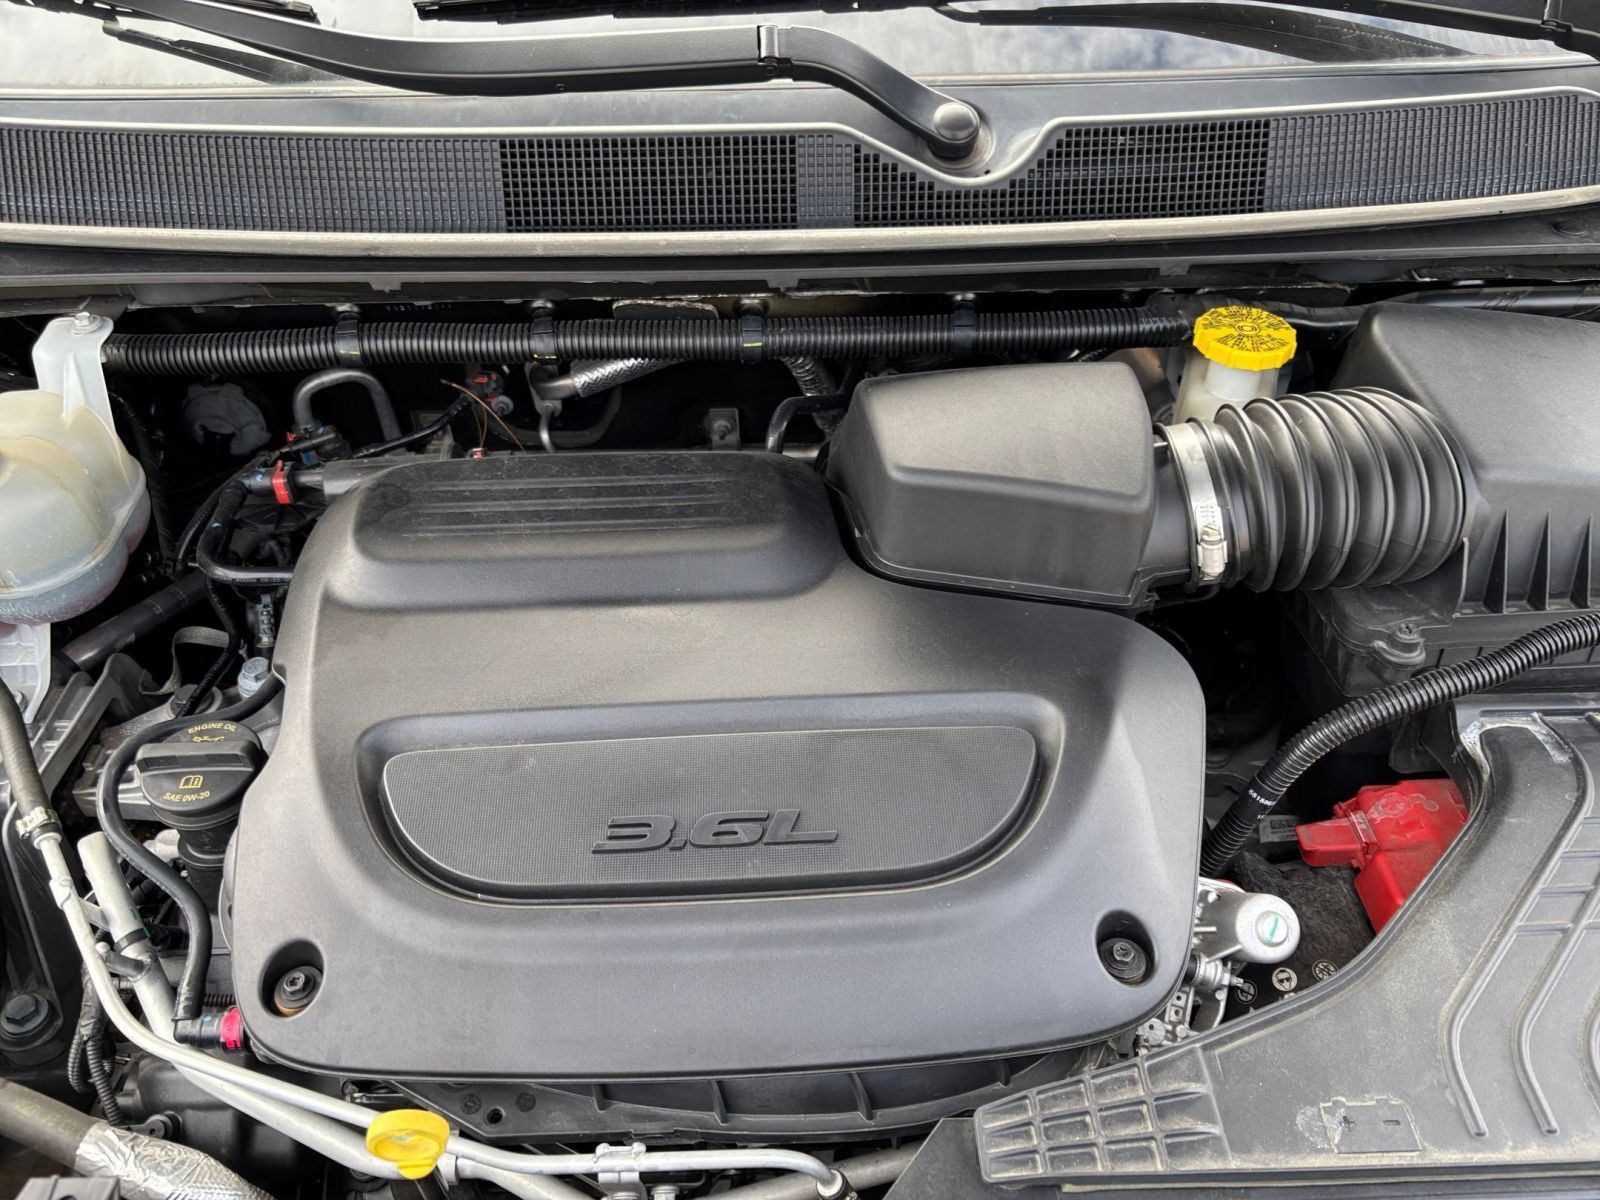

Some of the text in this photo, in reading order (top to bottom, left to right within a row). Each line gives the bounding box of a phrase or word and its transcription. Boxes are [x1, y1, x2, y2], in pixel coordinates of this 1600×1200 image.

[188, 722, 238, 734] ENGINE OIL
[163, 790, 210, 802] SAE 0W-20
[591, 808, 838, 855] 3.6L
